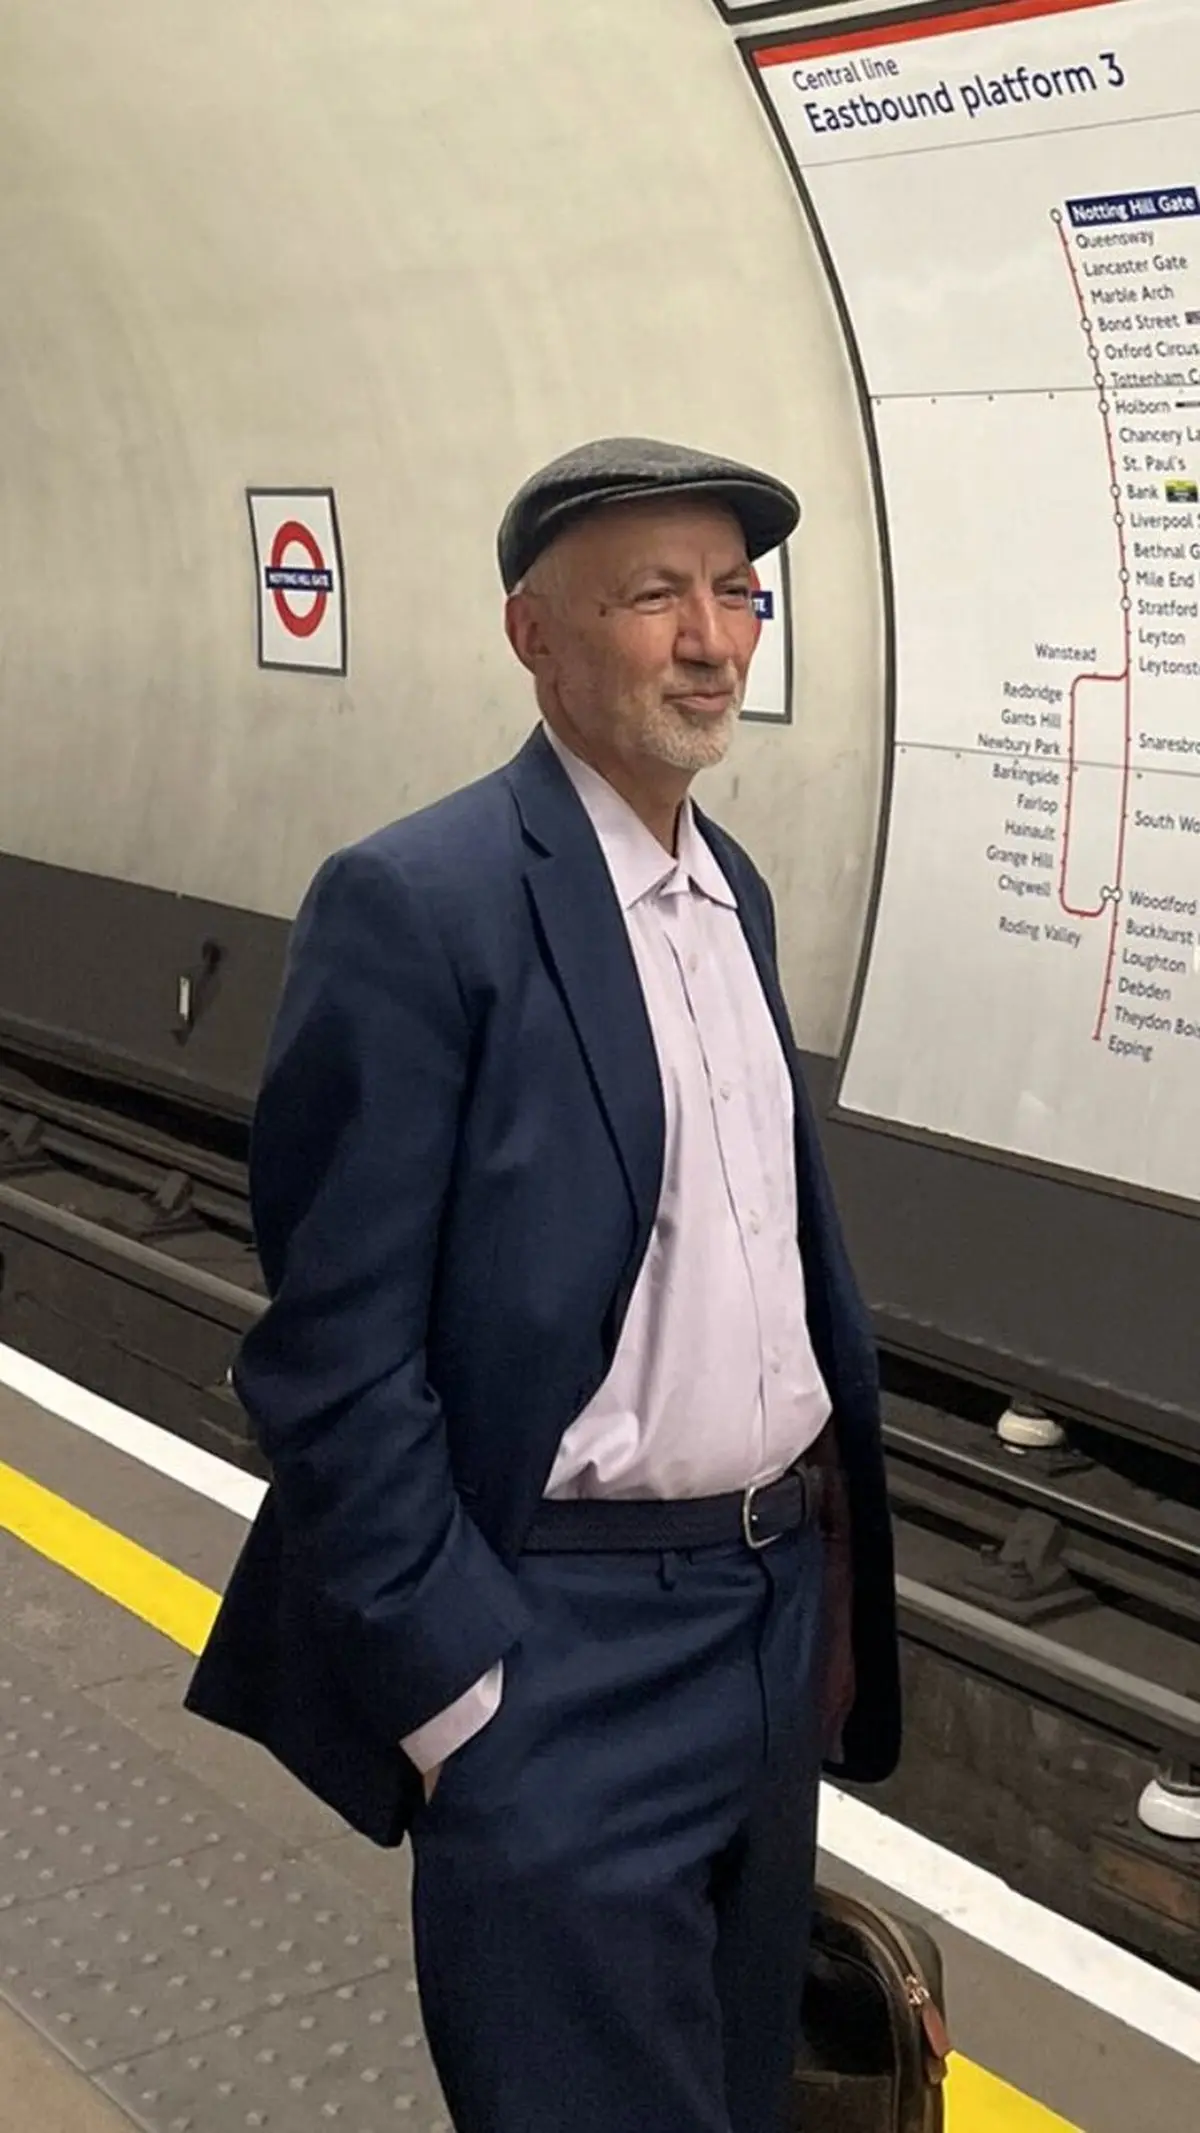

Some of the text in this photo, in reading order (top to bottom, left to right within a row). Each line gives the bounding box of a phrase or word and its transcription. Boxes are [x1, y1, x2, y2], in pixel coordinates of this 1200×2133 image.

[792, 57, 899, 91] Central line
[804, 52, 1124, 133] Eastbound platform 3
[1071, 196, 1196, 221] Notting Hill Gate
[1075, 231, 1154, 249] Queensway
[1082, 255, 1188, 277] Lancaster Gate
[1090, 284, 1174, 304] Marble Arch
[1098, 316, 1132, 332] Bond
[1135, 314, 1180, 329] Street
[1105, 343, 1152, 360] Oxford
[1110, 370, 1184, 389] Tottenham
[1116, 400, 1170, 414] Holborn
[1119, 427, 1182, 446] Chancery
[1145, 455, 1186, 471] Paul's
[1127, 484, 1159, 500] Bank
[1130, 512, 1193, 531] Liverpool
[1134, 542, 1185, 559] Bethnal
[1136, 571, 1194, 588] Mile End
[1138, 598, 1198, 618] Stratford
[1138, 627, 1186, 648] Leyton
[1035, 643, 1096, 662] Wanstead
[1003, 681, 1063, 704] Redbridge
[1001, 708, 1061, 729] Gants Hill
[978, 733, 1060, 756] Newbury Park
[992, 763, 1059, 786] Barkingside
[1017, 793, 1058, 816] Fairlop
[1004, 819, 1056, 841] Hainault
[1135, 810, 1175, 830] South
[986, 844, 1054, 869] Grange Hill
[998, 874, 1051, 897] Chigwell
[1129, 890, 1197, 916] Woodford
[999, 916, 1081, 949] Roding Valley
[1125, 917, 1194, 945] Buckhurst
[1122, 948, 1186, 974] Loughton
[1118, 977, 1171, 1001] Debden
[1115, 1005, 1172, 1031] Theydon
[1107, 1035, 1153, 1063] Epping
